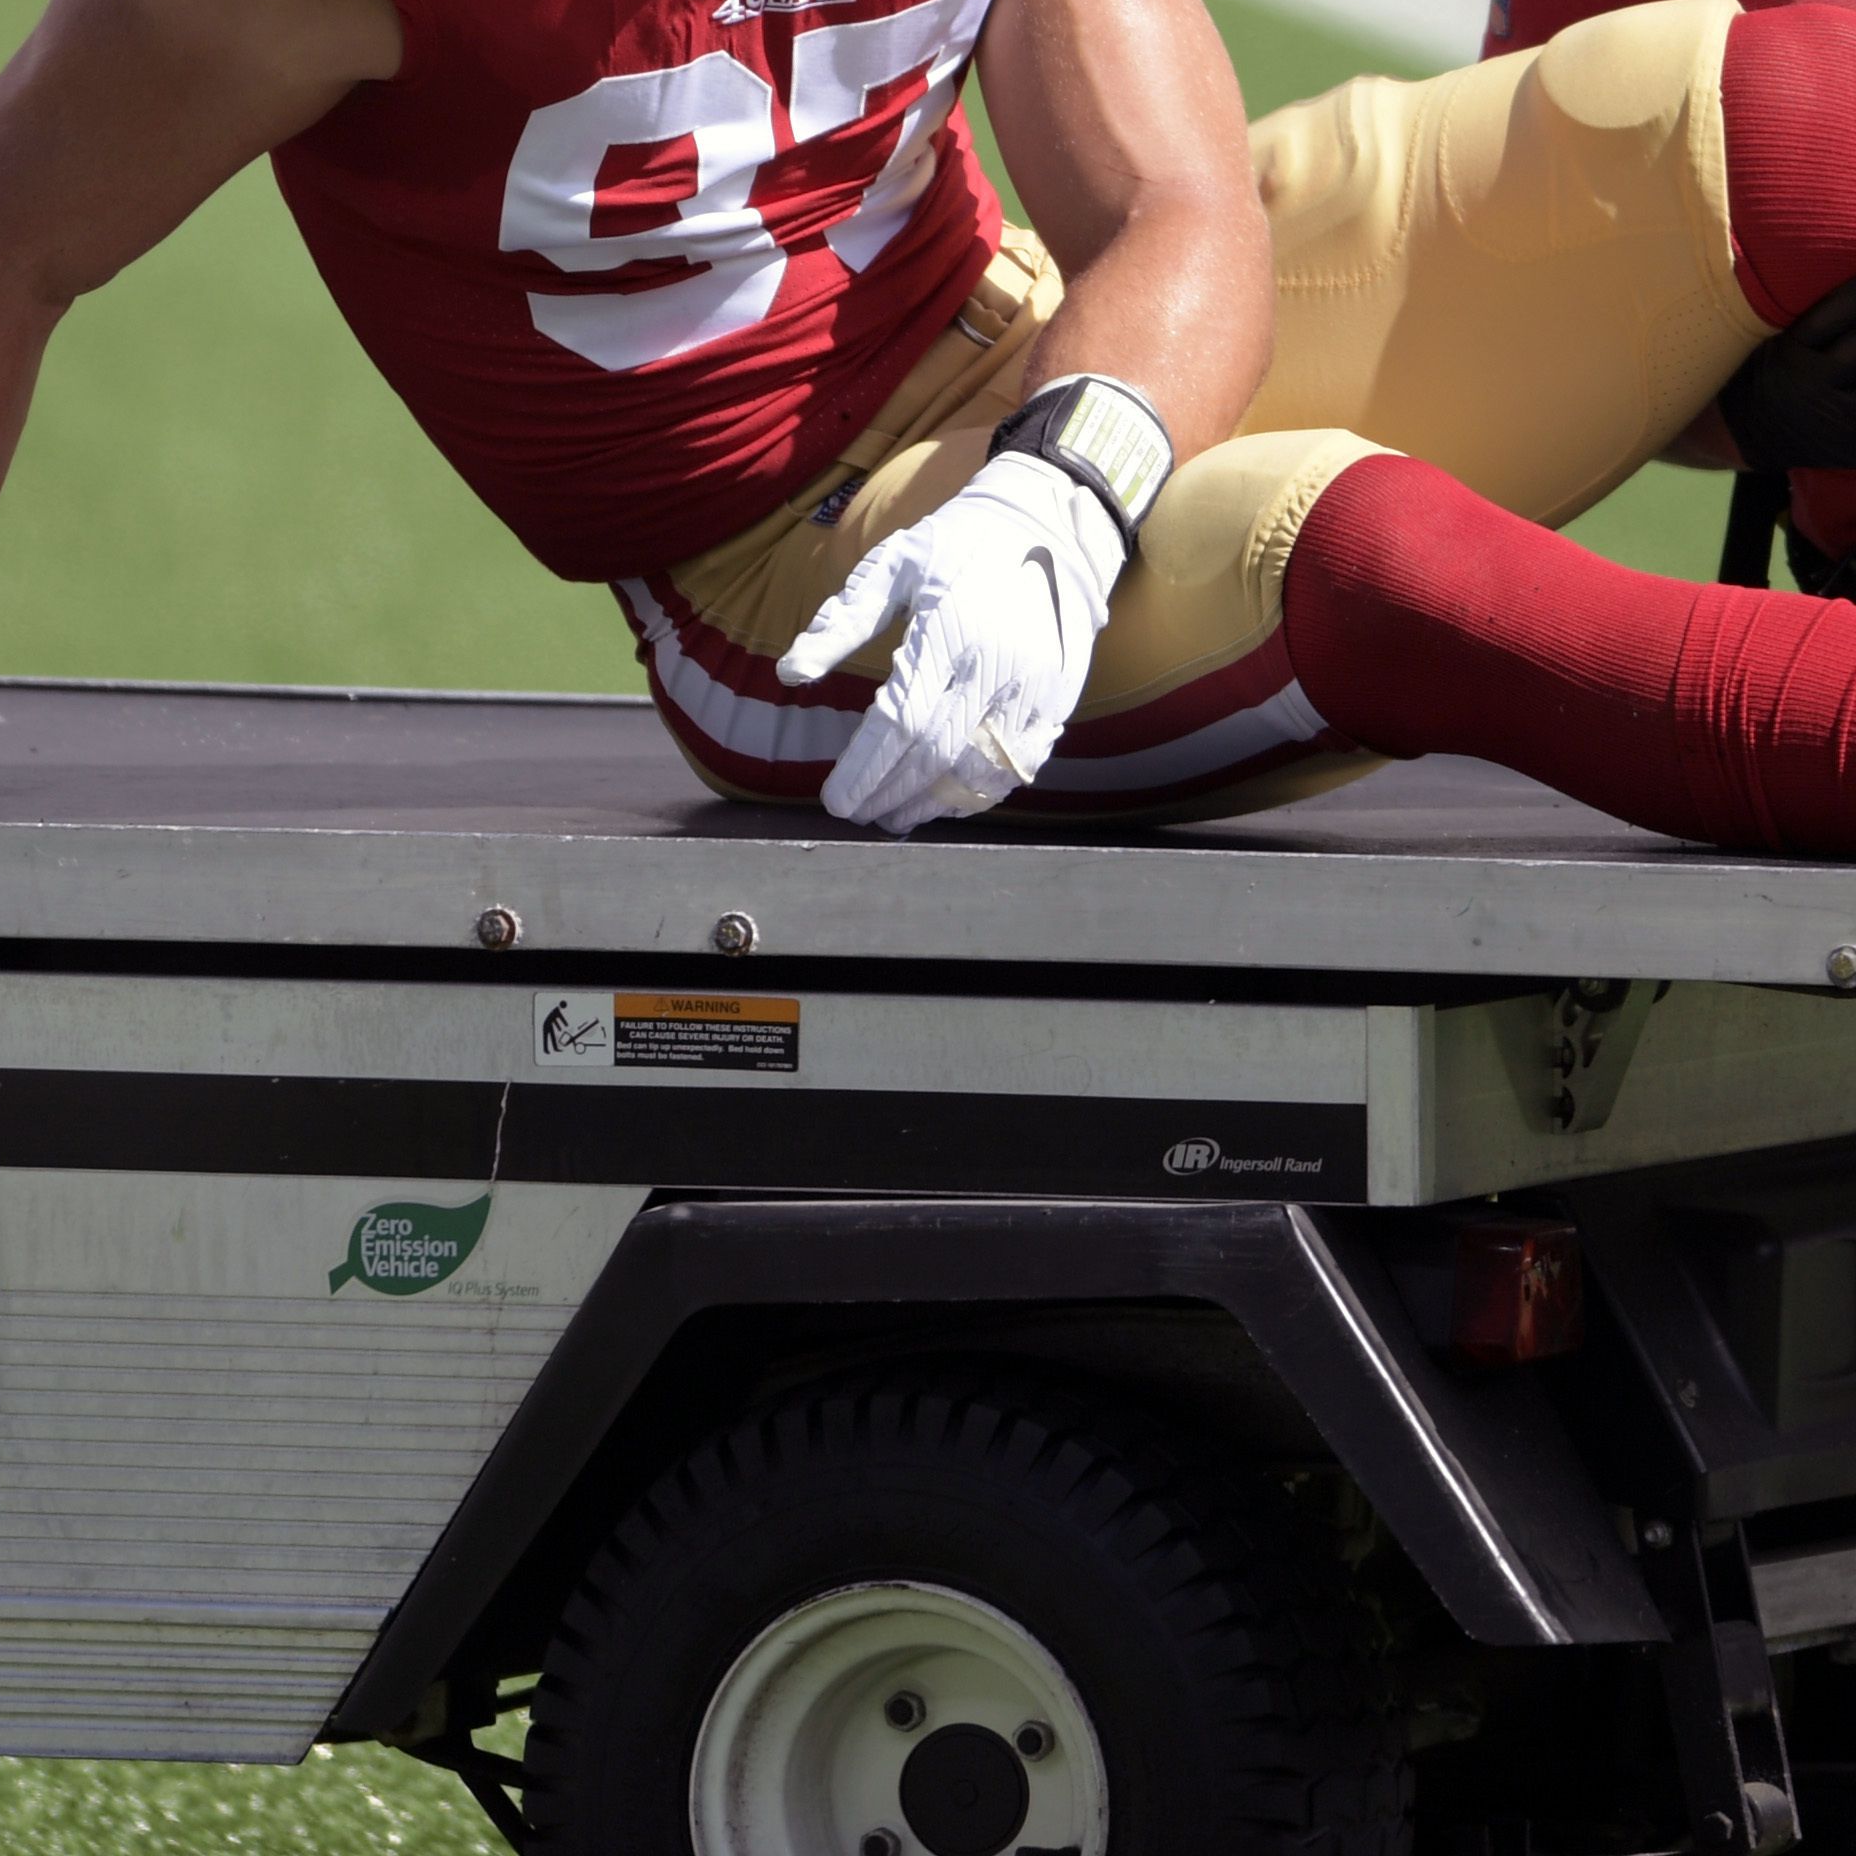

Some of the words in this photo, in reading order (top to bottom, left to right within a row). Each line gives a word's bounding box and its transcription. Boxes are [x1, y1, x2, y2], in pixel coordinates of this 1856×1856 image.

[670, 999, 741, 1014] WARNING
[620, 1021, 653, 1030] FAILURE
[655, 1022, 667, 1030] TO
[668, 1022, 703, 1031] FOLLOW
[705, 1023, 731, 1032] THESE
[732, 1025, 792, 1034] INSTRUCTIONS
[629, 1031, 647, 1039] CAN
[648, 1031, 675, 1040] CAUSE
[678, 1032, 711, 1041] SEVERE
[712, 1033, 741, 1042] INJURY
[741, 1034, 754, 1042] OR
[755, 1034, 784, 1043] DEATH.
[616, 1041, 632, 1049] Bed
[660, 1044, 671, 1052] up
[672, 1044, 724, 1053] unexpectedly.
[744, 1045, 762, 1054] hold
[763, 1046, 785, 1054] down
[616, 1051, 636, 1059] bolts
[658, 1051, 668, 1060] be
[669, 1052, 704, 1061] fastened.
[1172, 1143, 1211, 1169] IR
[1220, 1155, 1282, 1174] Ingersoll
[1284, 1158, 1323, 1173] Rand
[361, 1213, 412, 1236] Zero
[361, 1235, 458, 1257] Emission
[362, 1255, 439, 1278] Vehicle
[447, 1282, 464, 1296] IQ
[465, 1282, 492, 1296] Plus
[494, 1282, 540, 1299] System
